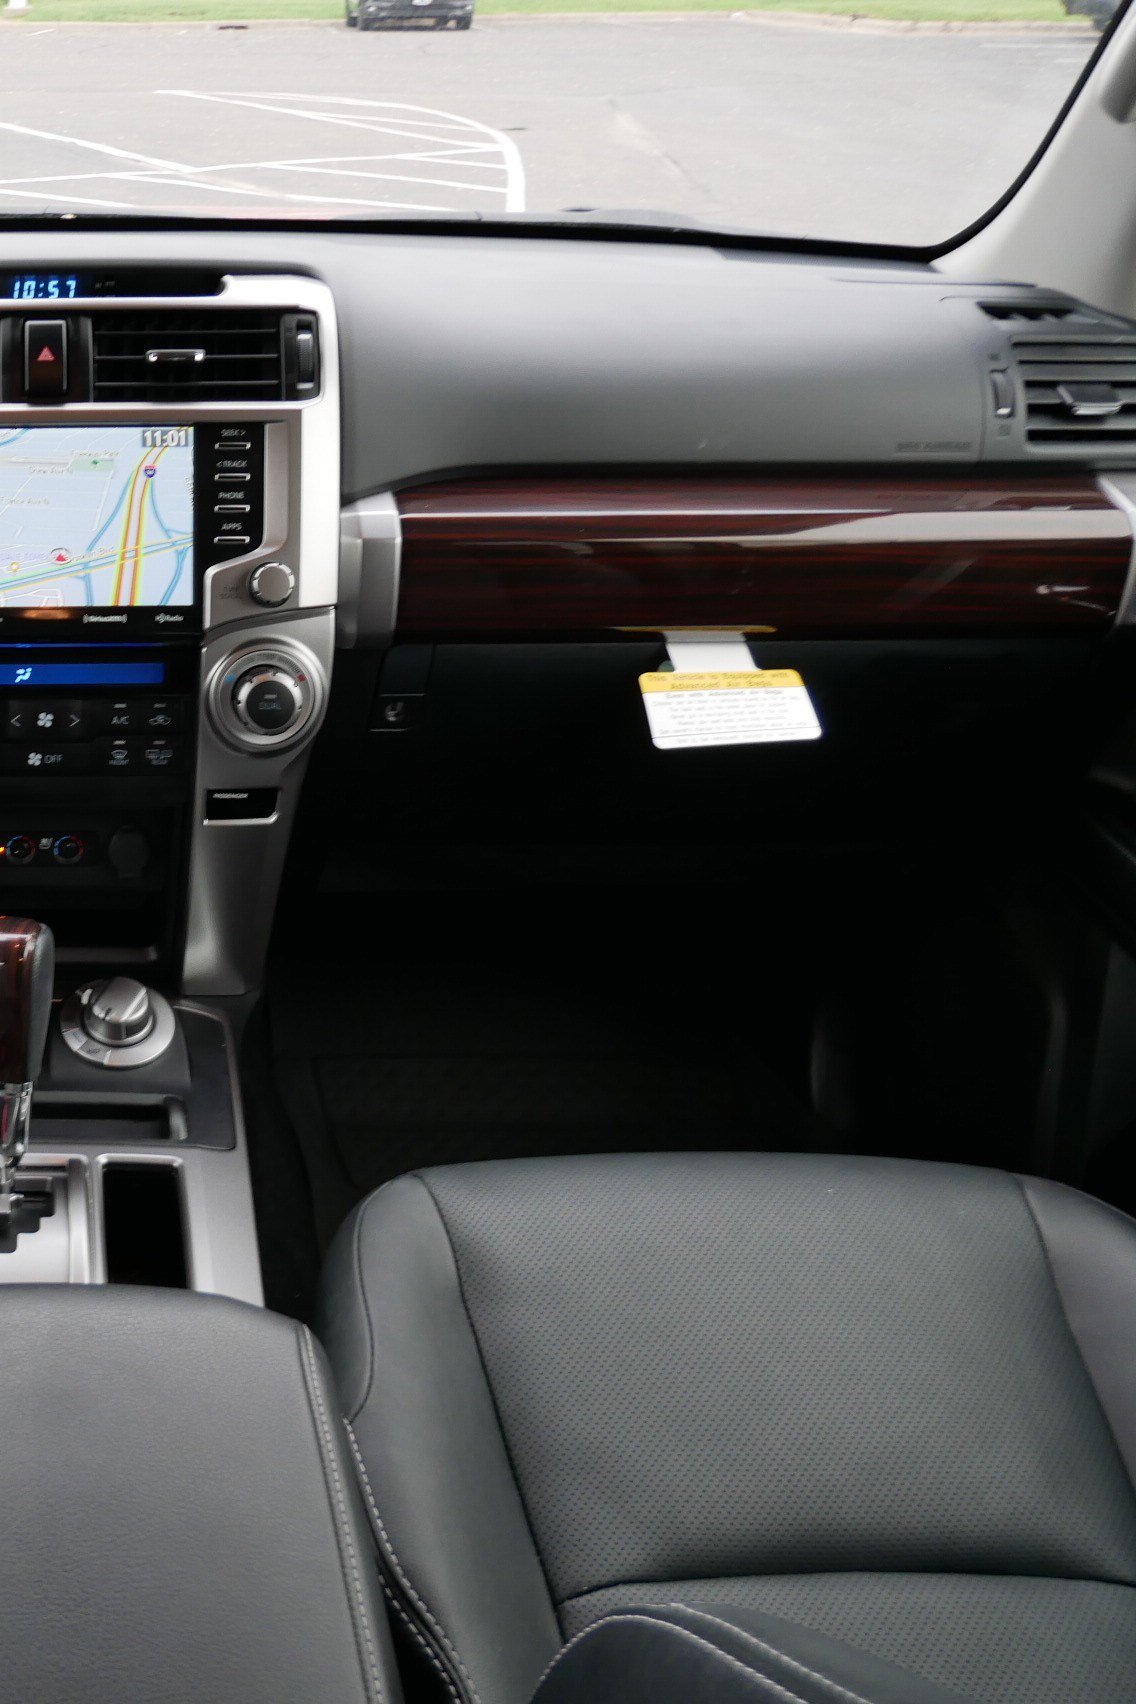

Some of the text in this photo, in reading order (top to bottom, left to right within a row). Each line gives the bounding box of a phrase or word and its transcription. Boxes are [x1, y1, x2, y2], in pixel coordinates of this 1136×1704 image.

[13, 279, 77, 299] 10:57
[144, 429, 186, 447] 11:01
[218, 491, 245, 500] PHONE
[221, 522, 243, 531] APPS
[771, 671, 789, 679] with
[670, 681, 720, 690] Advanced
[746, 680, 773, 690] Bags
[110, 715, 130, 725] A/C
[44, 754, 64, 764] OFF
